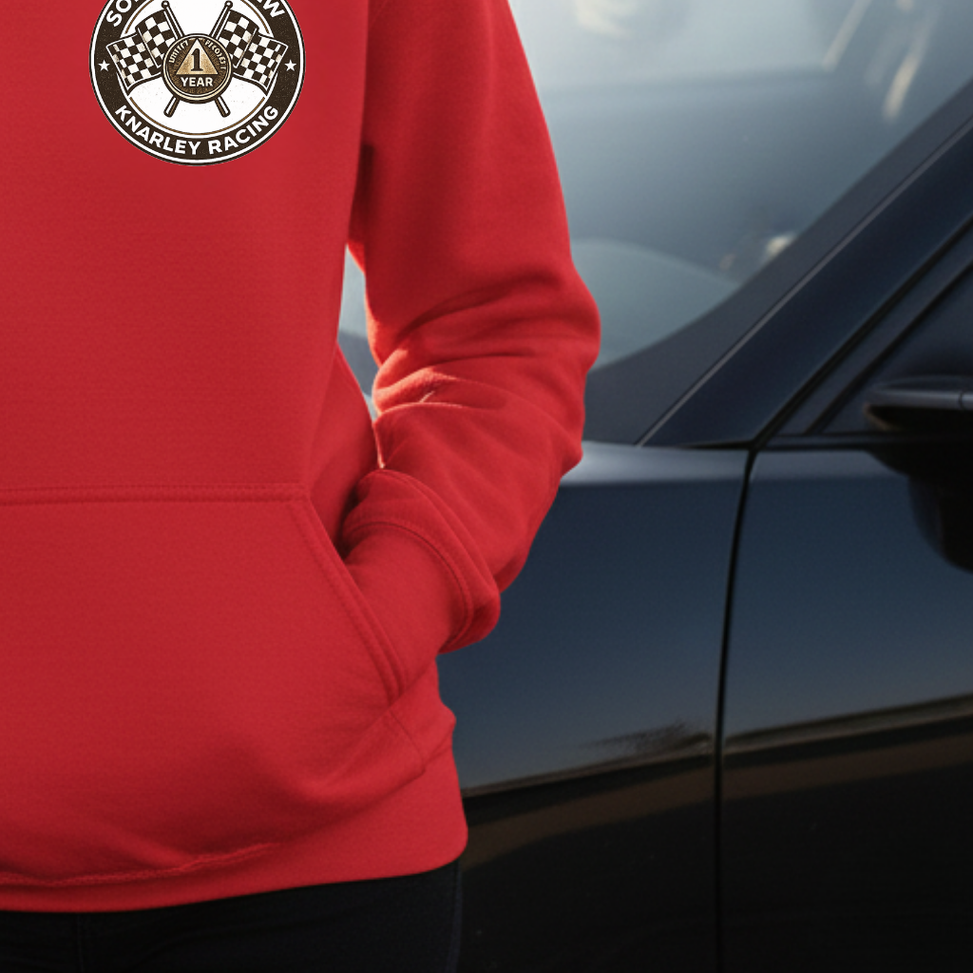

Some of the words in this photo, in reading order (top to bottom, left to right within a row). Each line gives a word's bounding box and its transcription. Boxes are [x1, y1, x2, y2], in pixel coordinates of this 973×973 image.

[190, 48, 204, 72] 1
[180, 77, 213, 87] YEAR
[114, 105, 201, 155] KNARLEY
[208, 105, 279, 155] RACING
